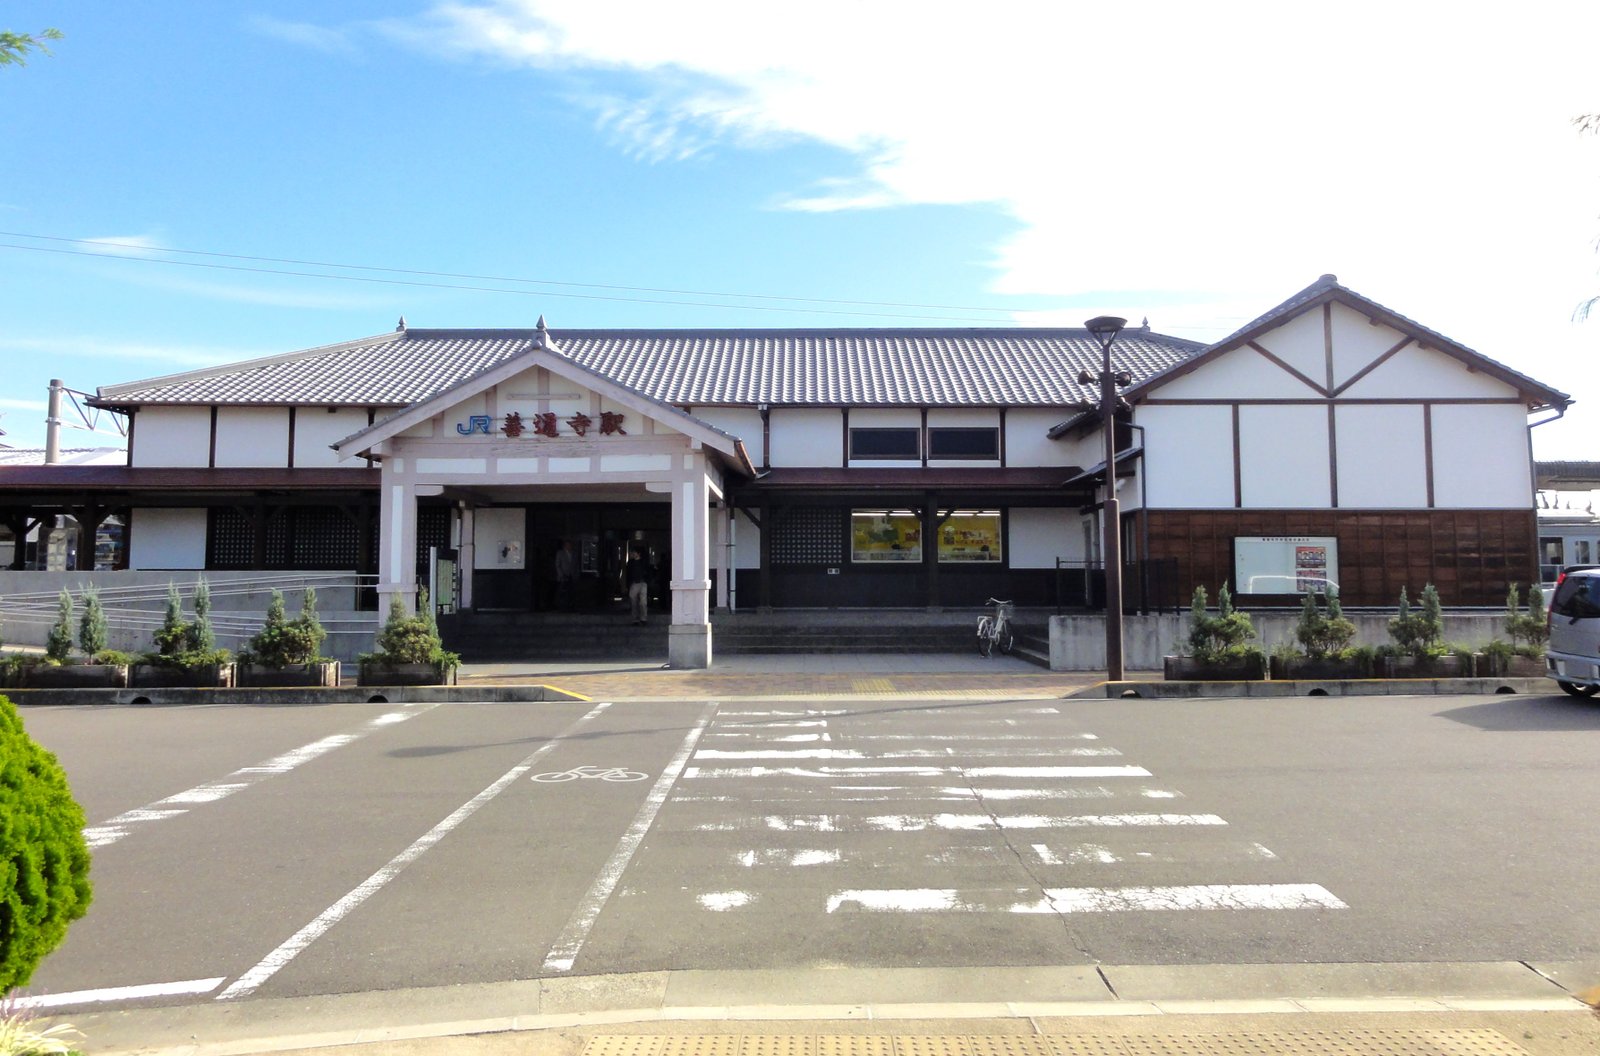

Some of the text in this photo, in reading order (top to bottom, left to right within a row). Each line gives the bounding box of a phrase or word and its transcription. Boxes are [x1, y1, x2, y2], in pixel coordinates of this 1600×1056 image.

[457, 411, 627, 438] JR 善通寺駅
